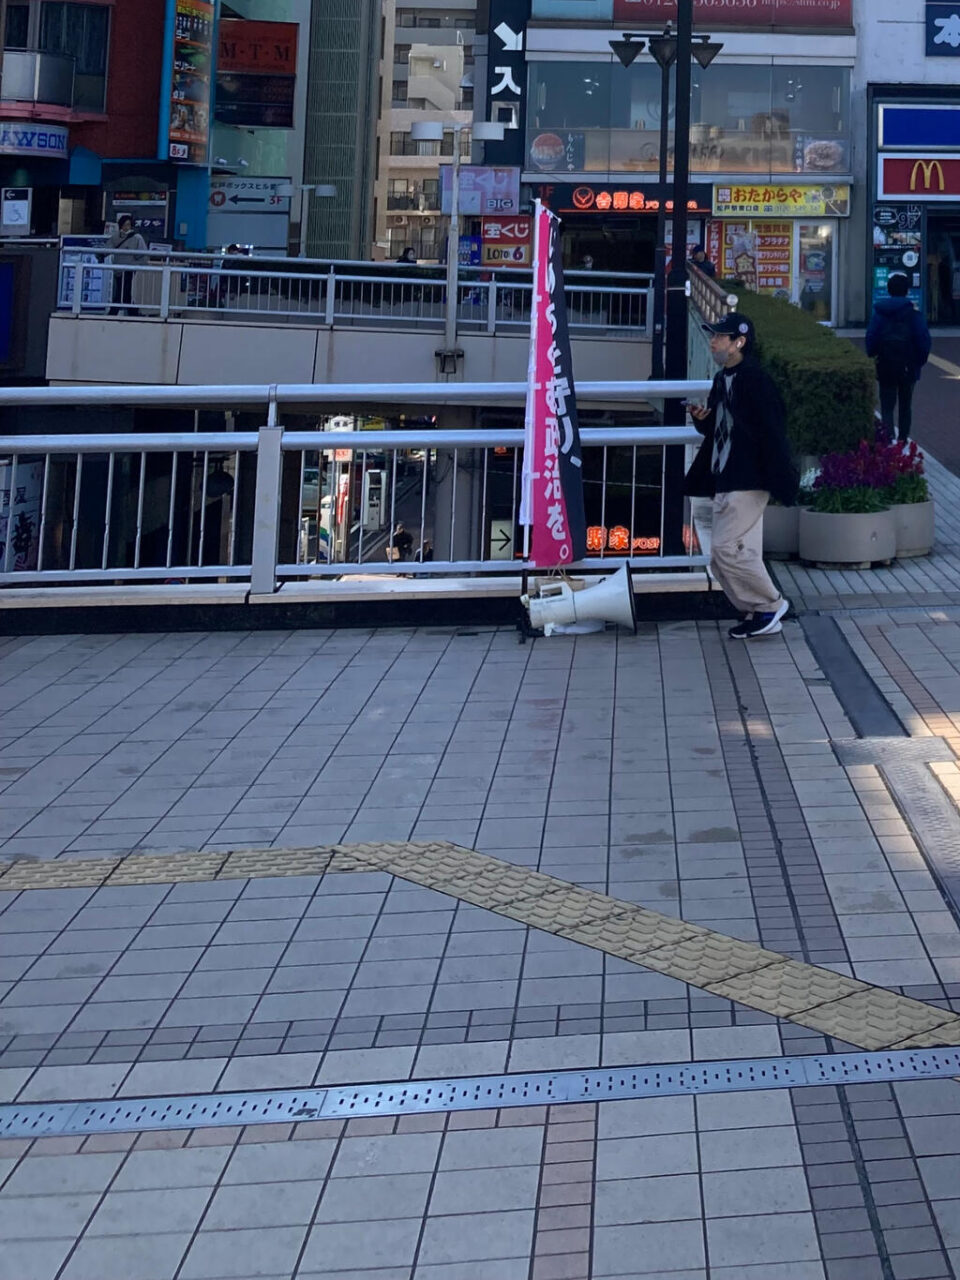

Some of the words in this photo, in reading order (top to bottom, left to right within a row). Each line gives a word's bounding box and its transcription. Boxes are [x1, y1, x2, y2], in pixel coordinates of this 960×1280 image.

[491, 66, 521, 129] 入口
[596, 192, 644, 209] 吉野家
[733, 187, 802, 203] おたからや
[487, 199, 514, 209] BIG
[484, 223, 529, 238] 宝くじ
[710, 221, 719, 272] ビル内エレ
[586, 526, 629, 550] 野家
